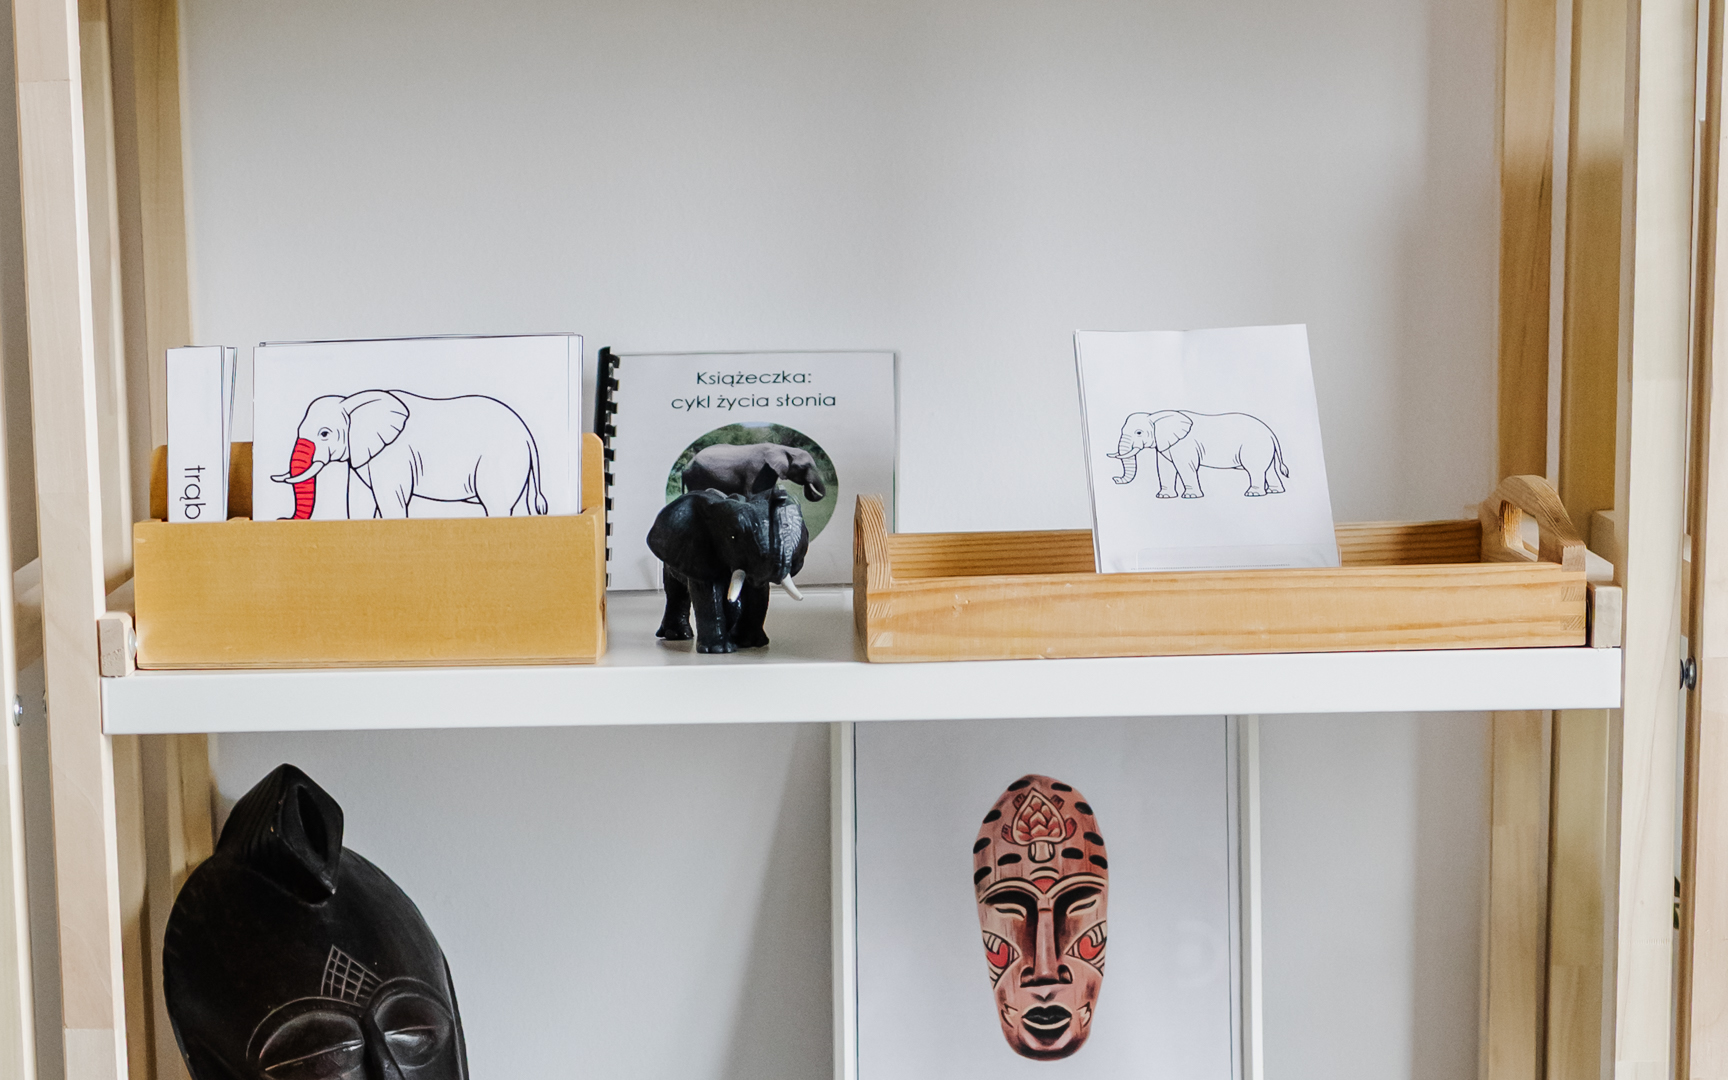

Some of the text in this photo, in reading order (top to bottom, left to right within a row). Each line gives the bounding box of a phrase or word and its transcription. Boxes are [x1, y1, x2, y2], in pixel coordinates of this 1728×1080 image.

[696, 370, 812, 388] Książeczka:
[670, 392, 836, 412] cykl życia słonia
